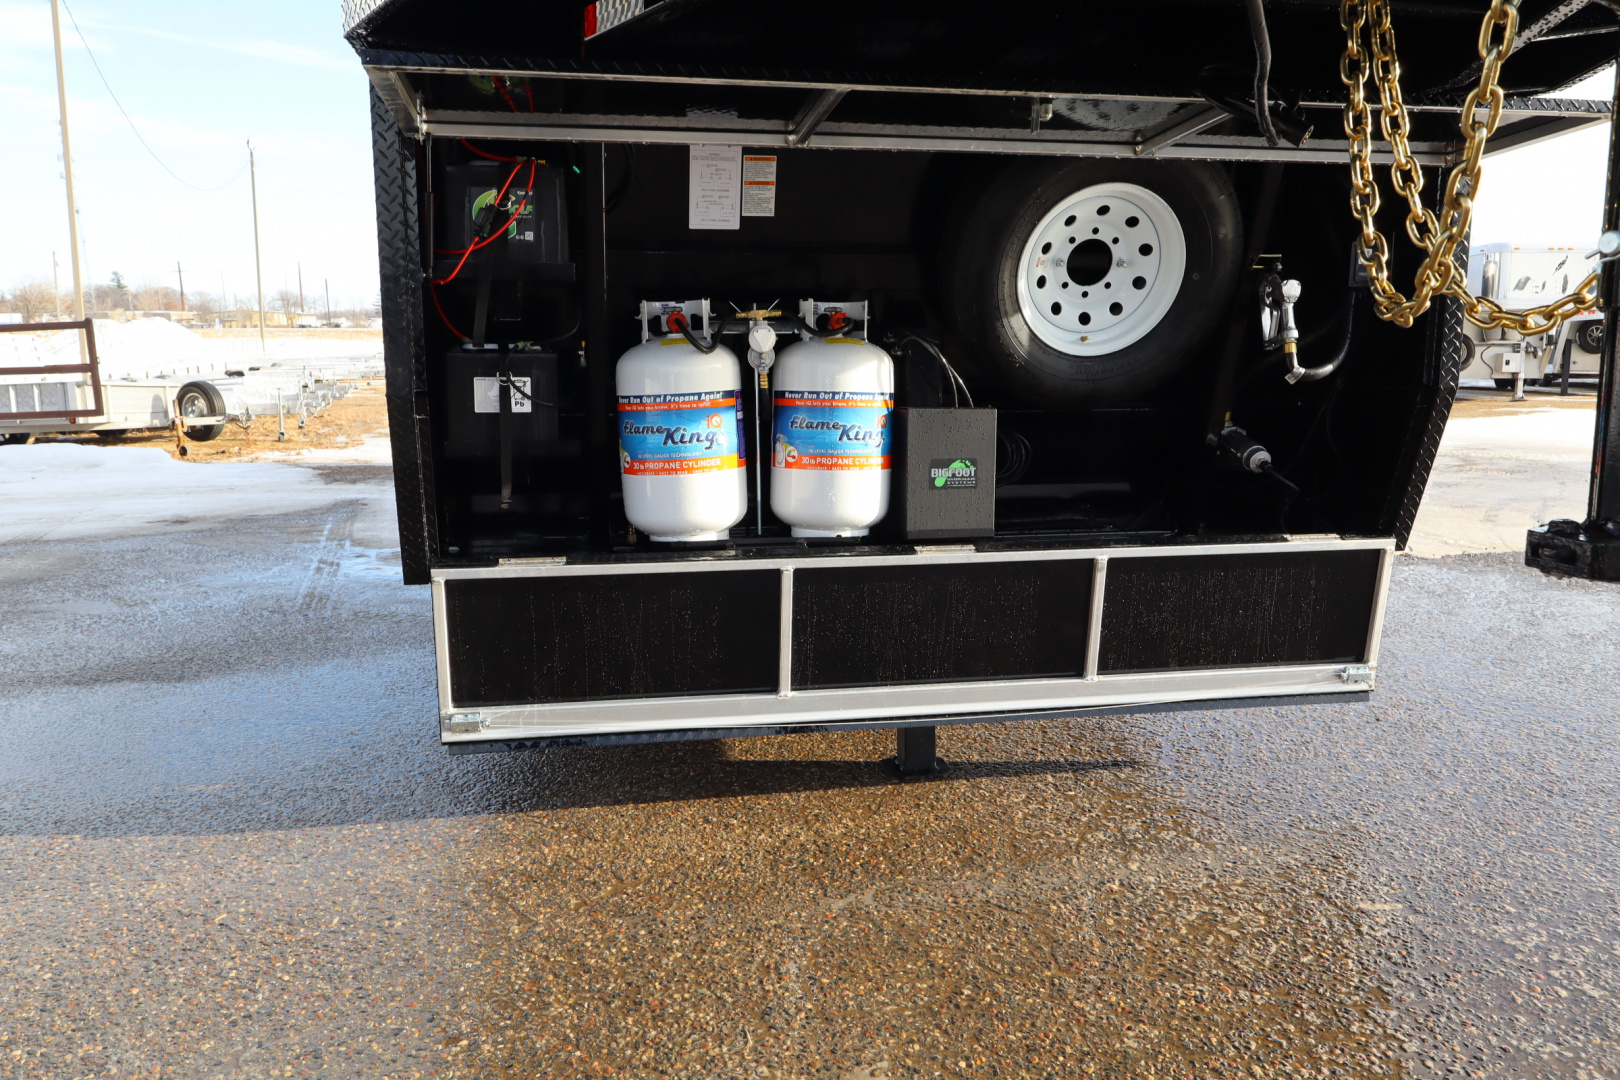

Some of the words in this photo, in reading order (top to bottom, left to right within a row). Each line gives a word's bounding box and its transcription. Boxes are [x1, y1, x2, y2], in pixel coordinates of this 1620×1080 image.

[666, 393, 698, 403] Propane
[834, 391, 843, 399] of
[845, 392, 873, 401] Propane
[662, 426, 717, 451] King
[837, 424, 885, 449] King
[645, 461, 681, 469] PROPANE
[682, 458, 722, 468] CYLINDER
[816, 457, 854, 465] PROPANE
[931, 468, 976, 478] BIGFOOT
